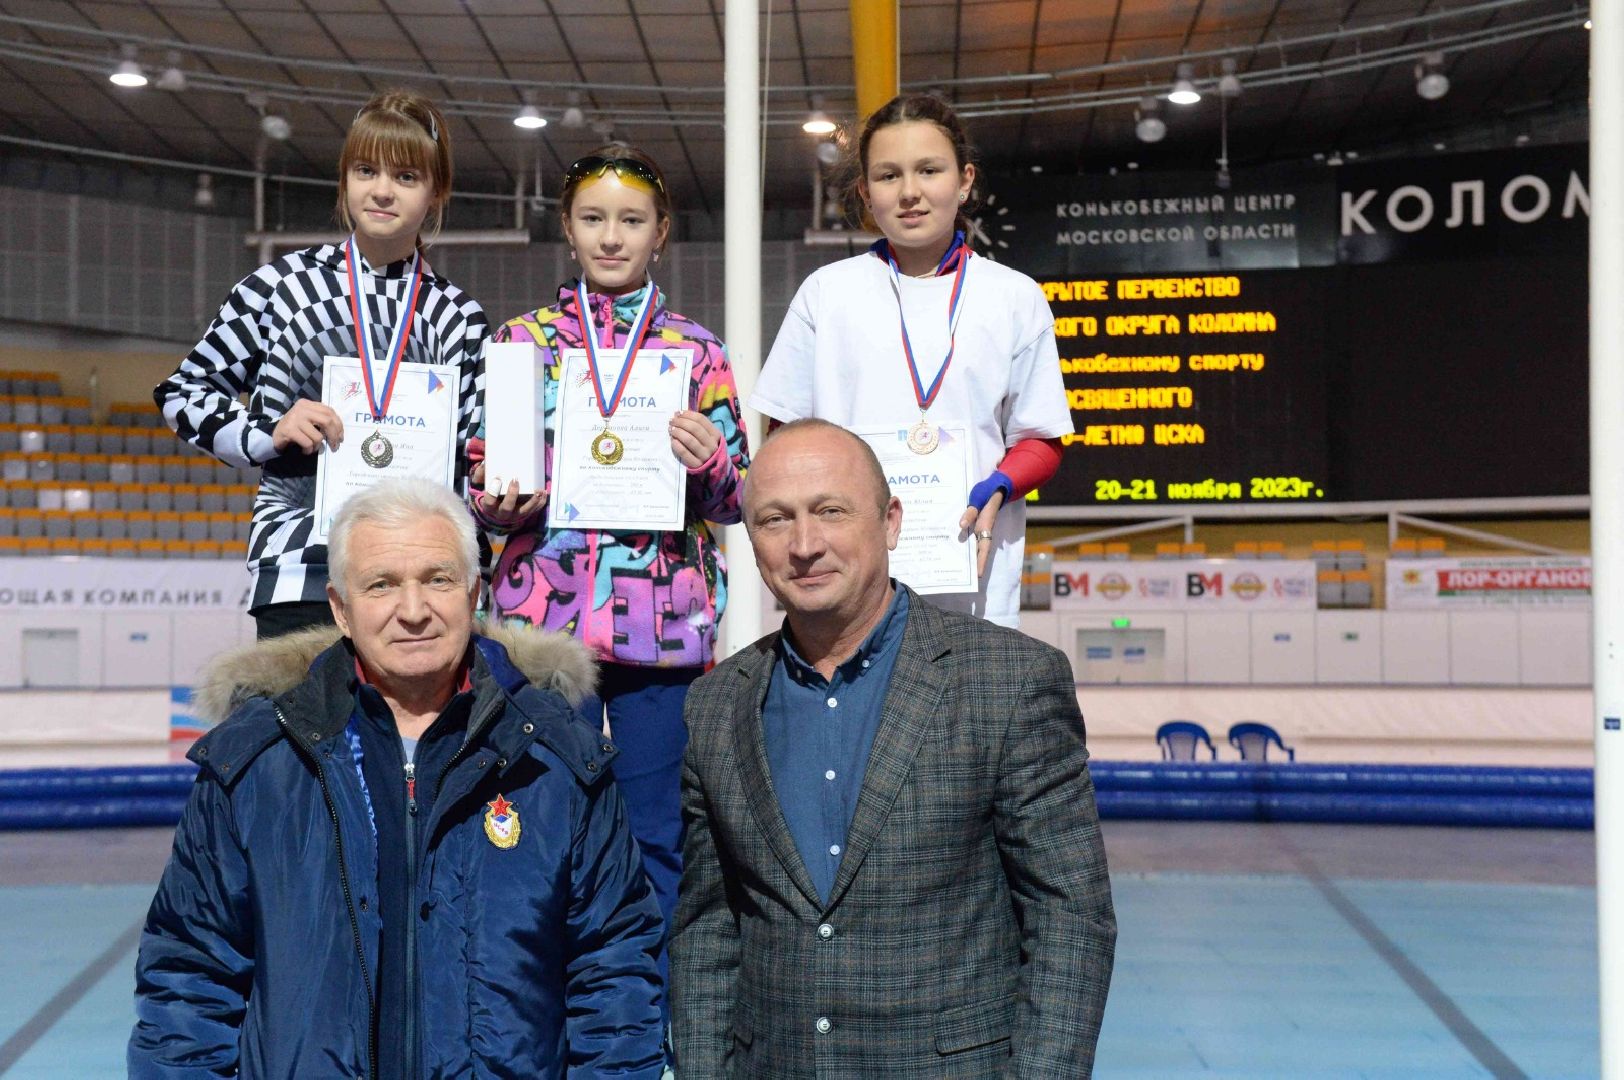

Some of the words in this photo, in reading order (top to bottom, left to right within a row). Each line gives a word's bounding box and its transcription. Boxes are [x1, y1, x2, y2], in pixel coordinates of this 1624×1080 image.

[1056, 195, 1225, 218] КОНЬКОБЕЖНЫЙ
[1234, 194, 1296, 213] ЦЕНТР
[1056, 225, 1195, 246] МОСКОВСКОЙ
[1203, 223, 1296, 241] ОБЛАСТИ
[1117, 276, 1240, 300] ПЕРВЕНСТВО
[1106, 314, 1181, 336] ОКРУГА
[1188, 311, 1277, 333] КОЛОМНА
[1189, 353, 1265, 372] спорту
[588, 396, 657, 408] ГМОТА
[1154, 423, 1206, 446] ЦСКА
[1095, 479, 1157, 500] 20-21
[1167, 478, 1242, 499] ноября
[1250, 477, 1324, 498] 2023г.
[84, 588, 222, 605] КОМПАНИЯ
